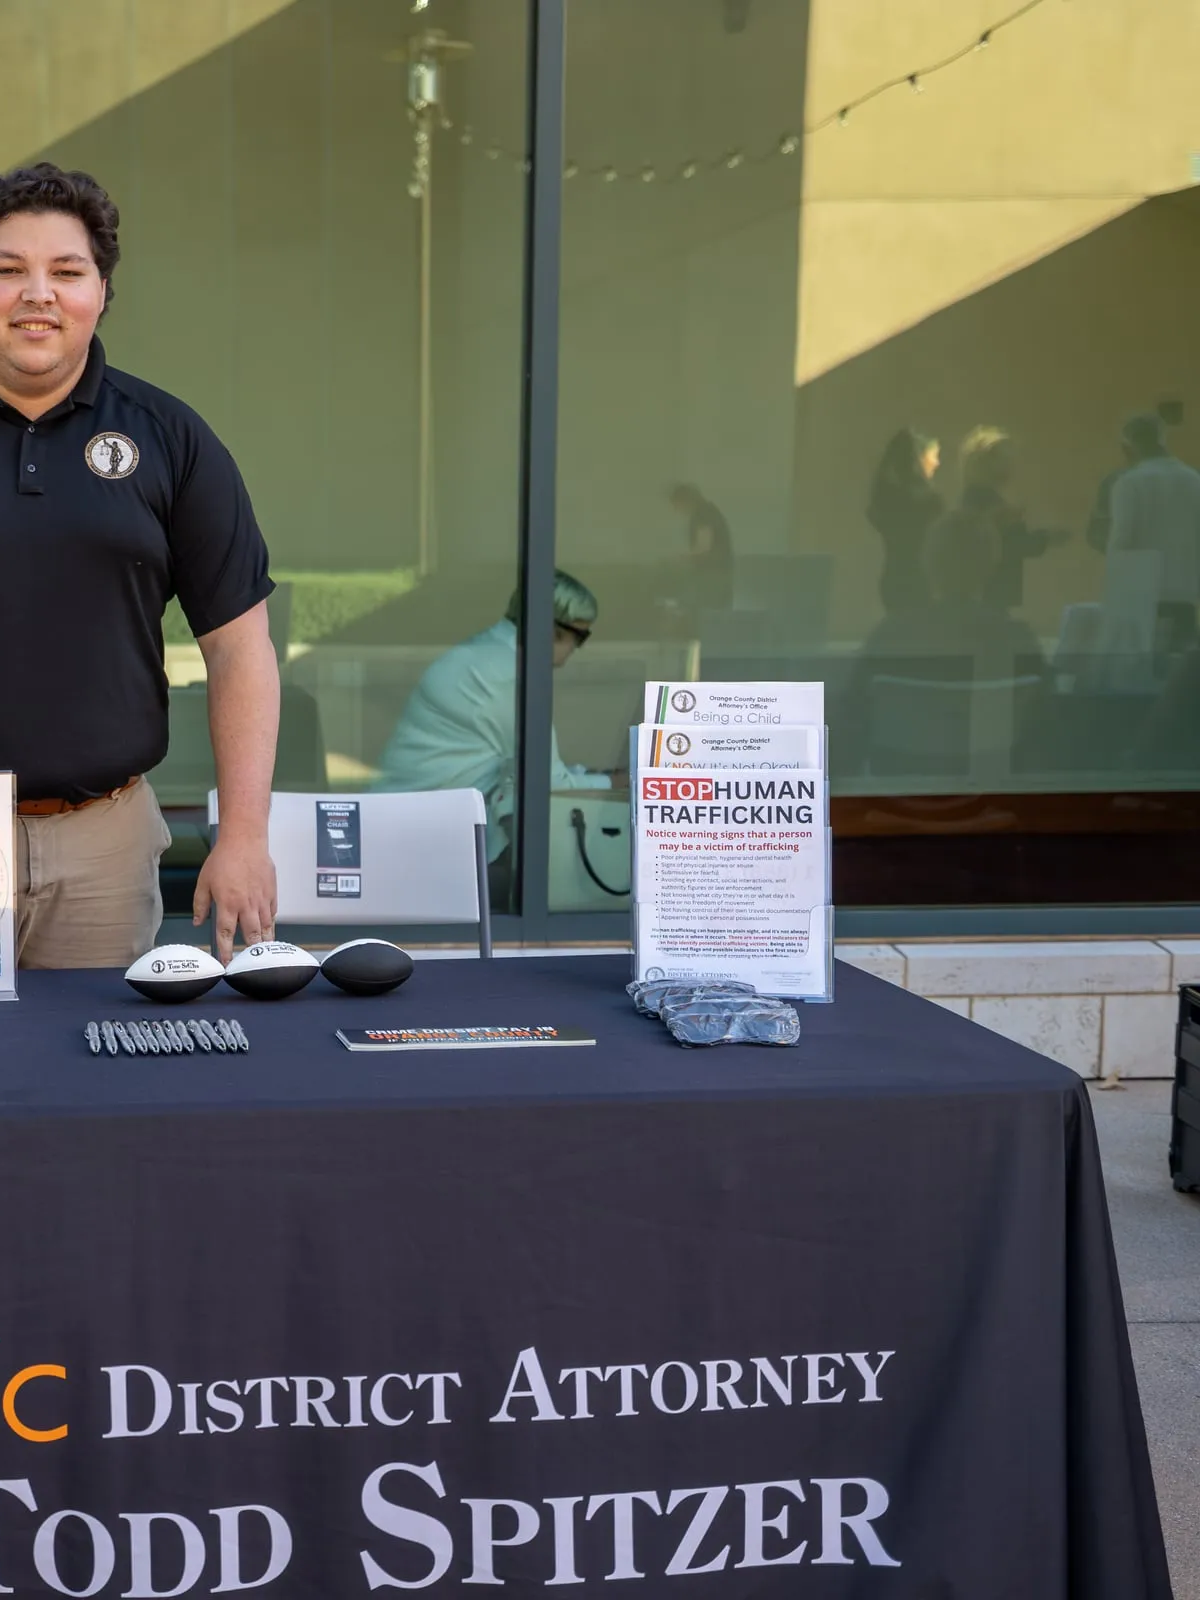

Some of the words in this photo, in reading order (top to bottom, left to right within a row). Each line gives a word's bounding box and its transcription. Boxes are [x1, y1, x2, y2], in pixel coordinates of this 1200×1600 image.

[718, 702, 749, 710] Attorney's
[693, 711, 730, 725] Being
[734, 714, 743, 723] a
[747, 712, 781, 725] Child
[646, 780, 712, 800] STOP
[714, 781, 815, 800] HUMAN
[644, 805, 813, 824] TRAFFICKING
[646, 830, 677, 838] Notice
[679, 831, 718, 840] warning
[721, 831, 744, 840] signs
[779, 832, 812, 840] person
[681, 842, 693, 850] be
[703, 843, 733, 851] victim
[736, 843, 746, 851] of
[748, 843, 799, 852] trafficking
[368, 1032, 459, 1040] ORANGE
[468, 1029, 558, 1037] COUNTY
